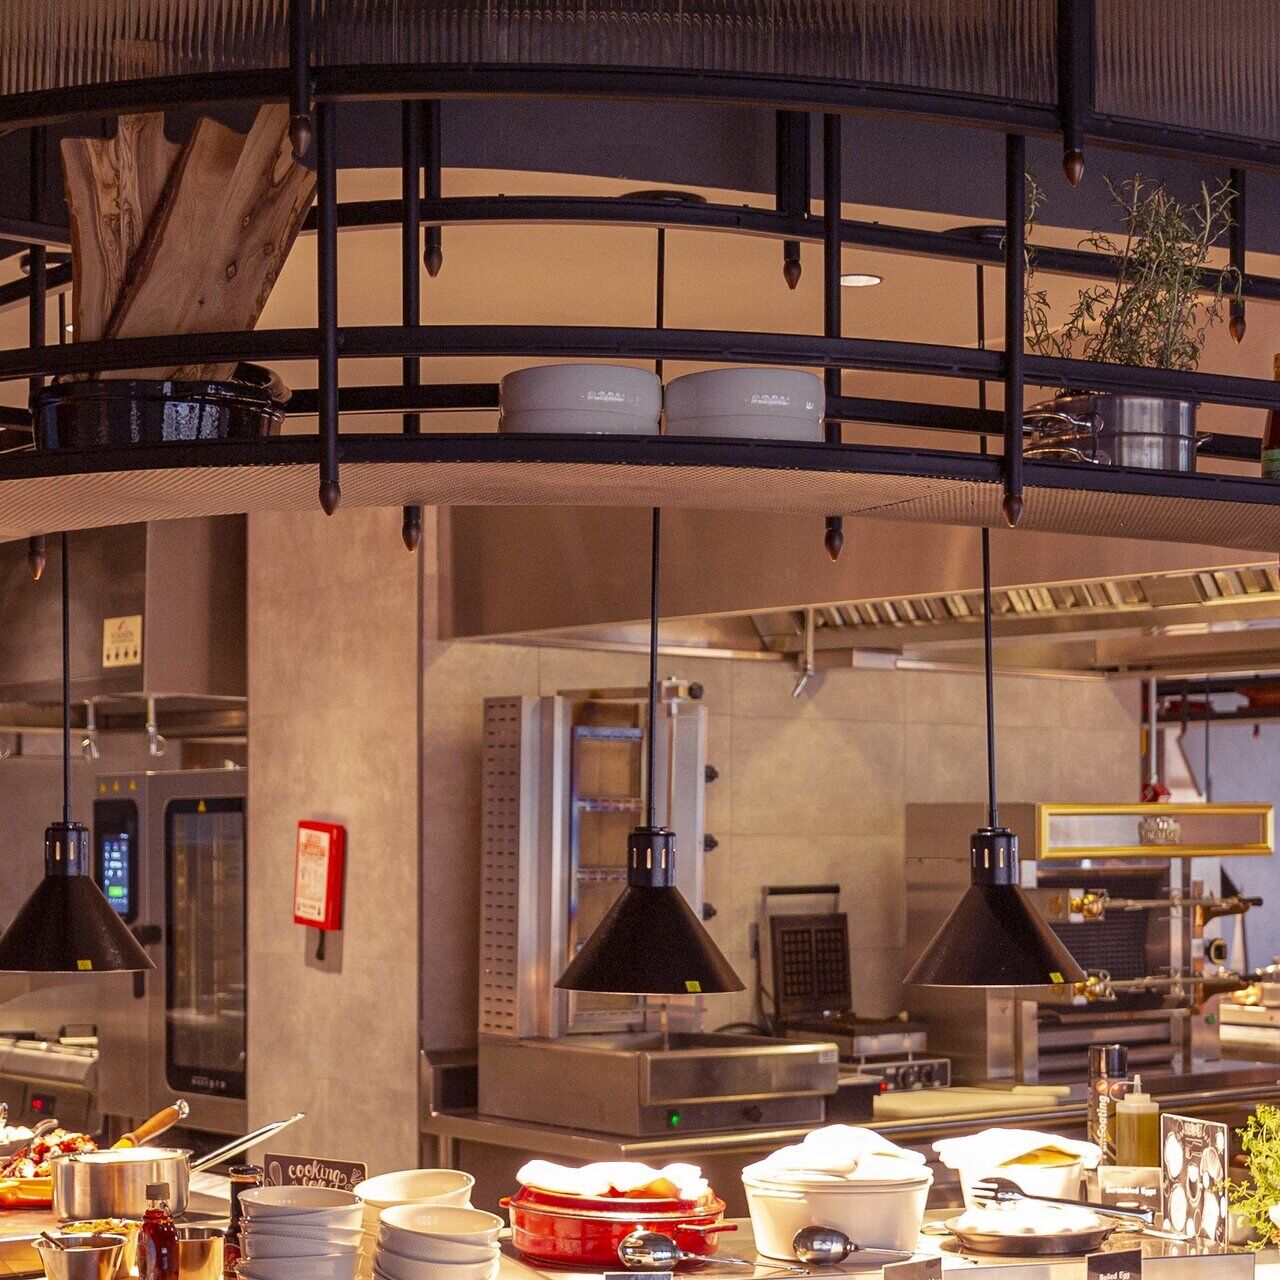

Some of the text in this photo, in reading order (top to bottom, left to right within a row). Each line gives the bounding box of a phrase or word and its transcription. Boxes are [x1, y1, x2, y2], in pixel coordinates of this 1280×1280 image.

[288, 1160, 347, 1188] cooking
[1141, 1187, 1156, 1196] Eggs
[1099, 1271, 1130, 1280] Boiled Egg
